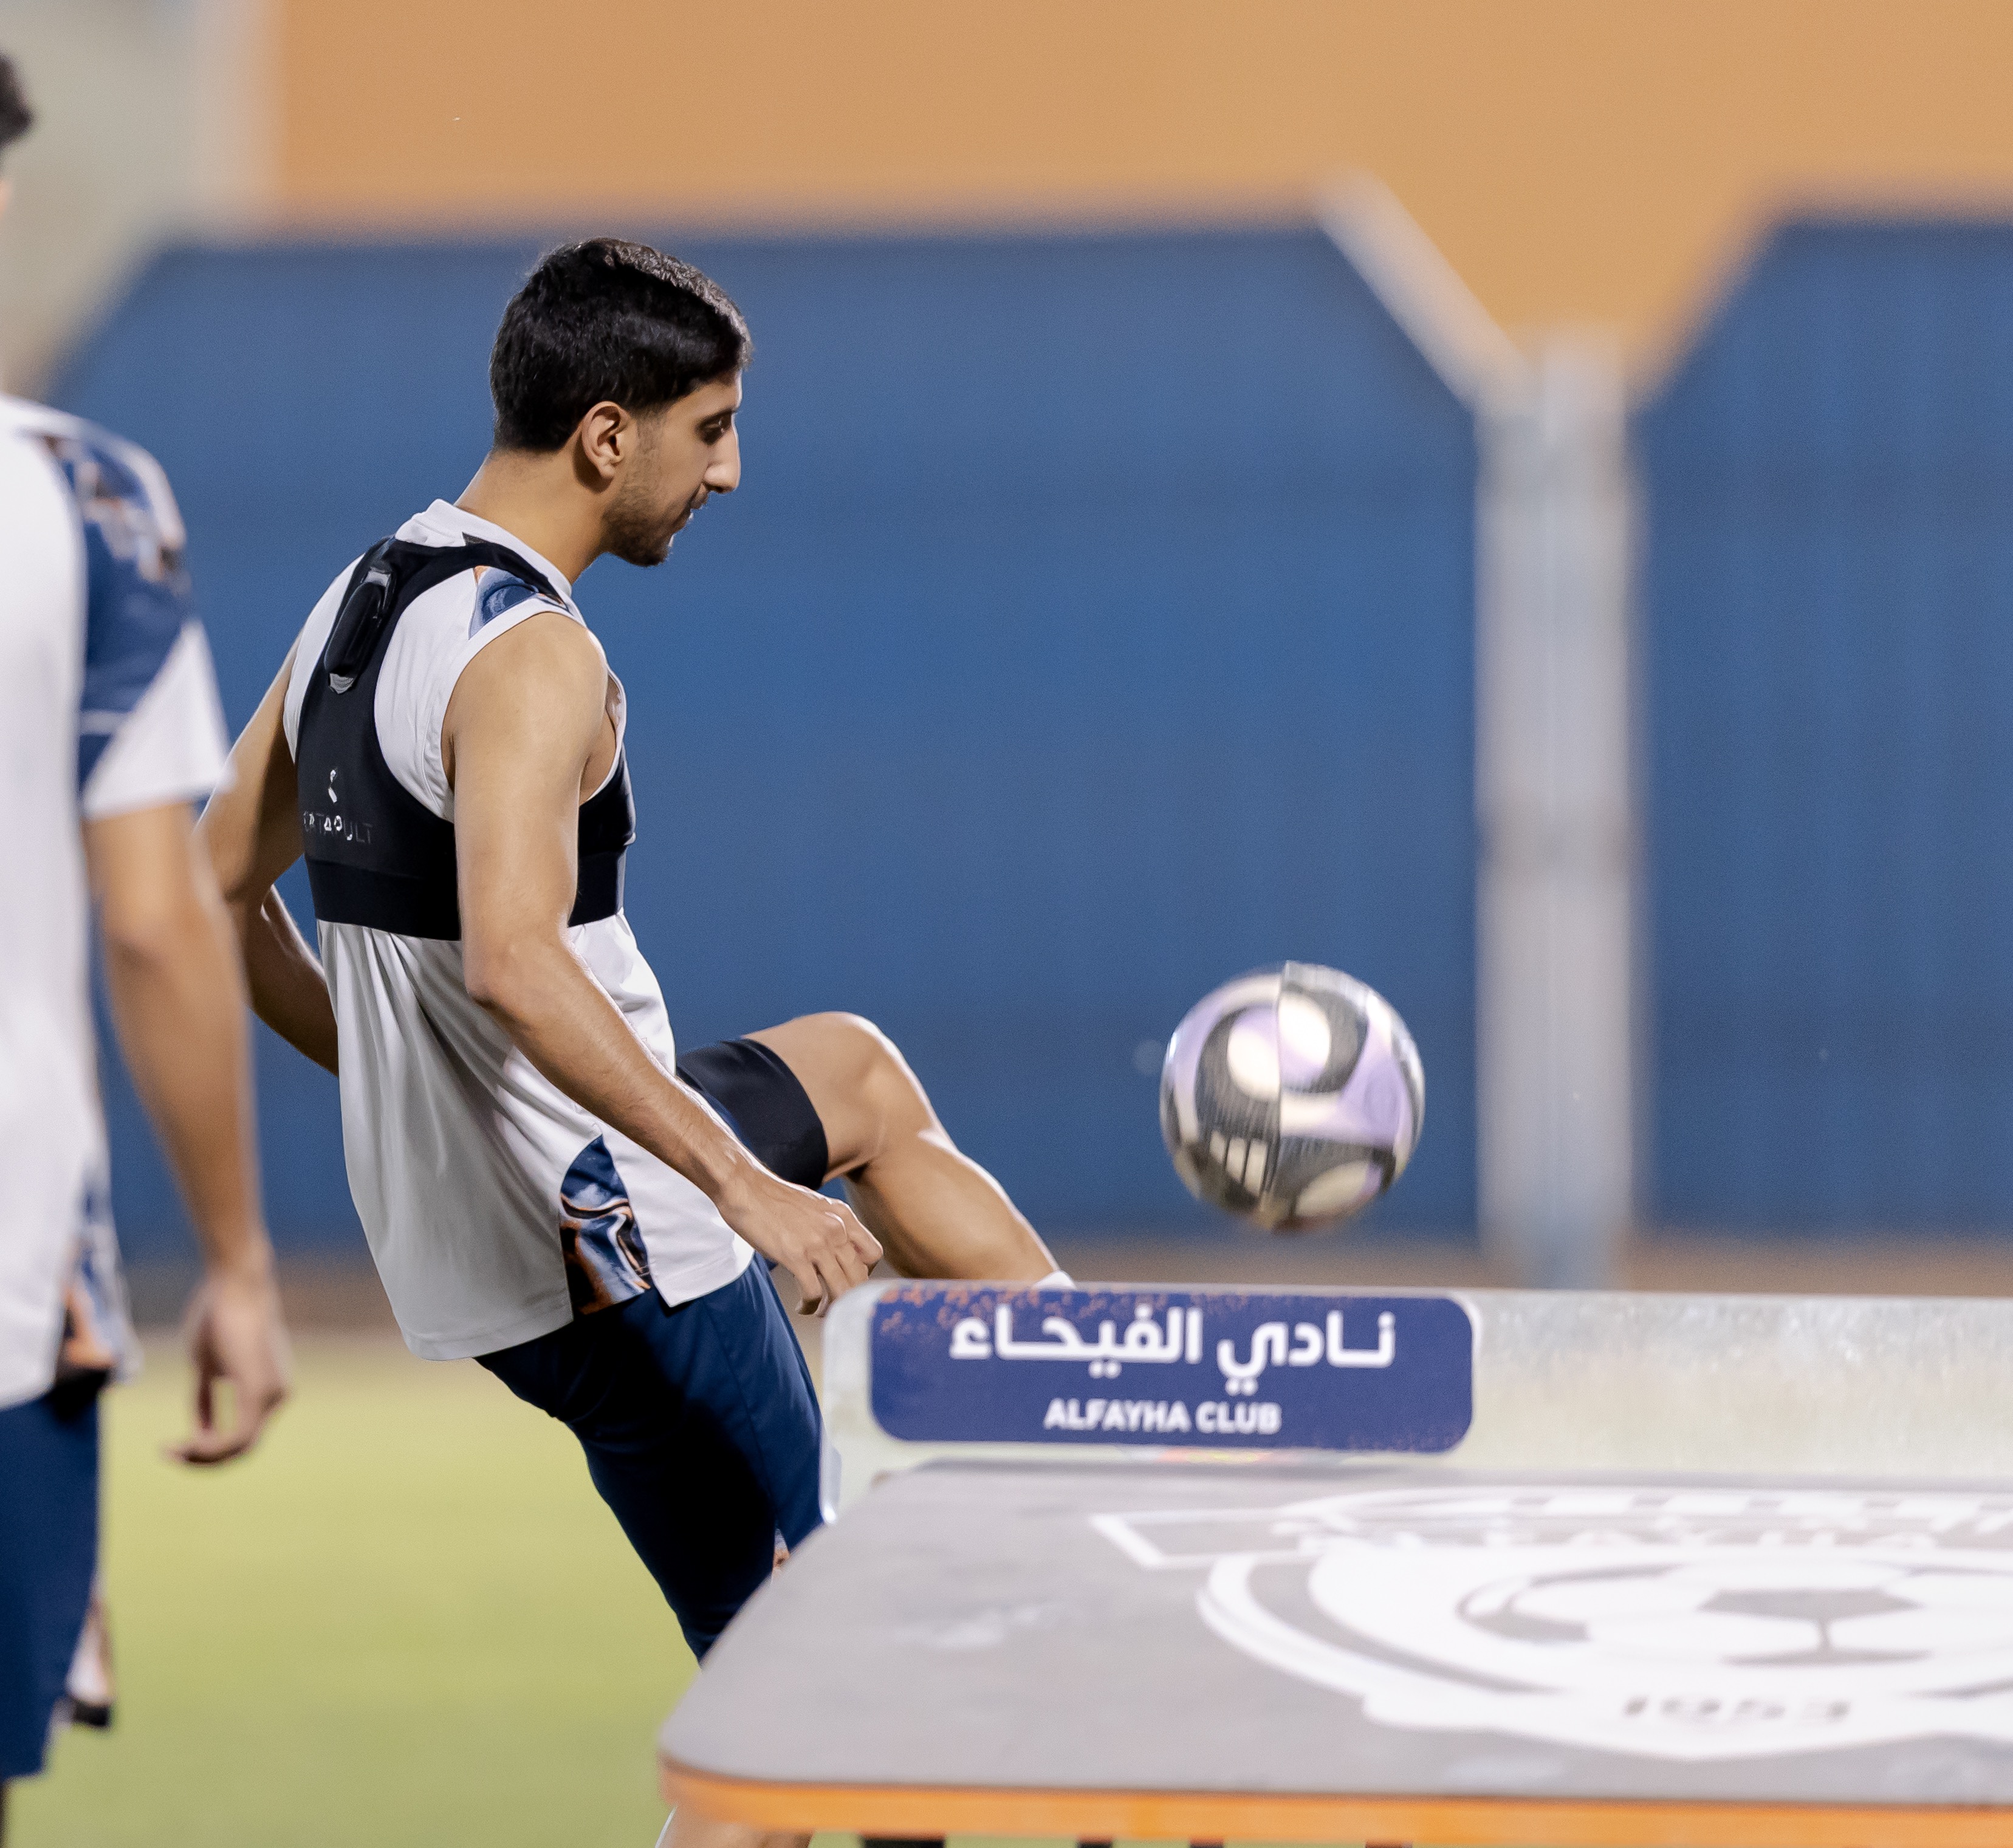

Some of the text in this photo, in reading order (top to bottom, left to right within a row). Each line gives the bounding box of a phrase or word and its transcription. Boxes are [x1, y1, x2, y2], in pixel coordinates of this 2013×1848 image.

[303, 811, 373, 844] CATAPULT
[949, 1302, 1396, 1396] نادي الفيحاء
[1043, 1398, 1282, 1435] ALFAYHA CLUB
